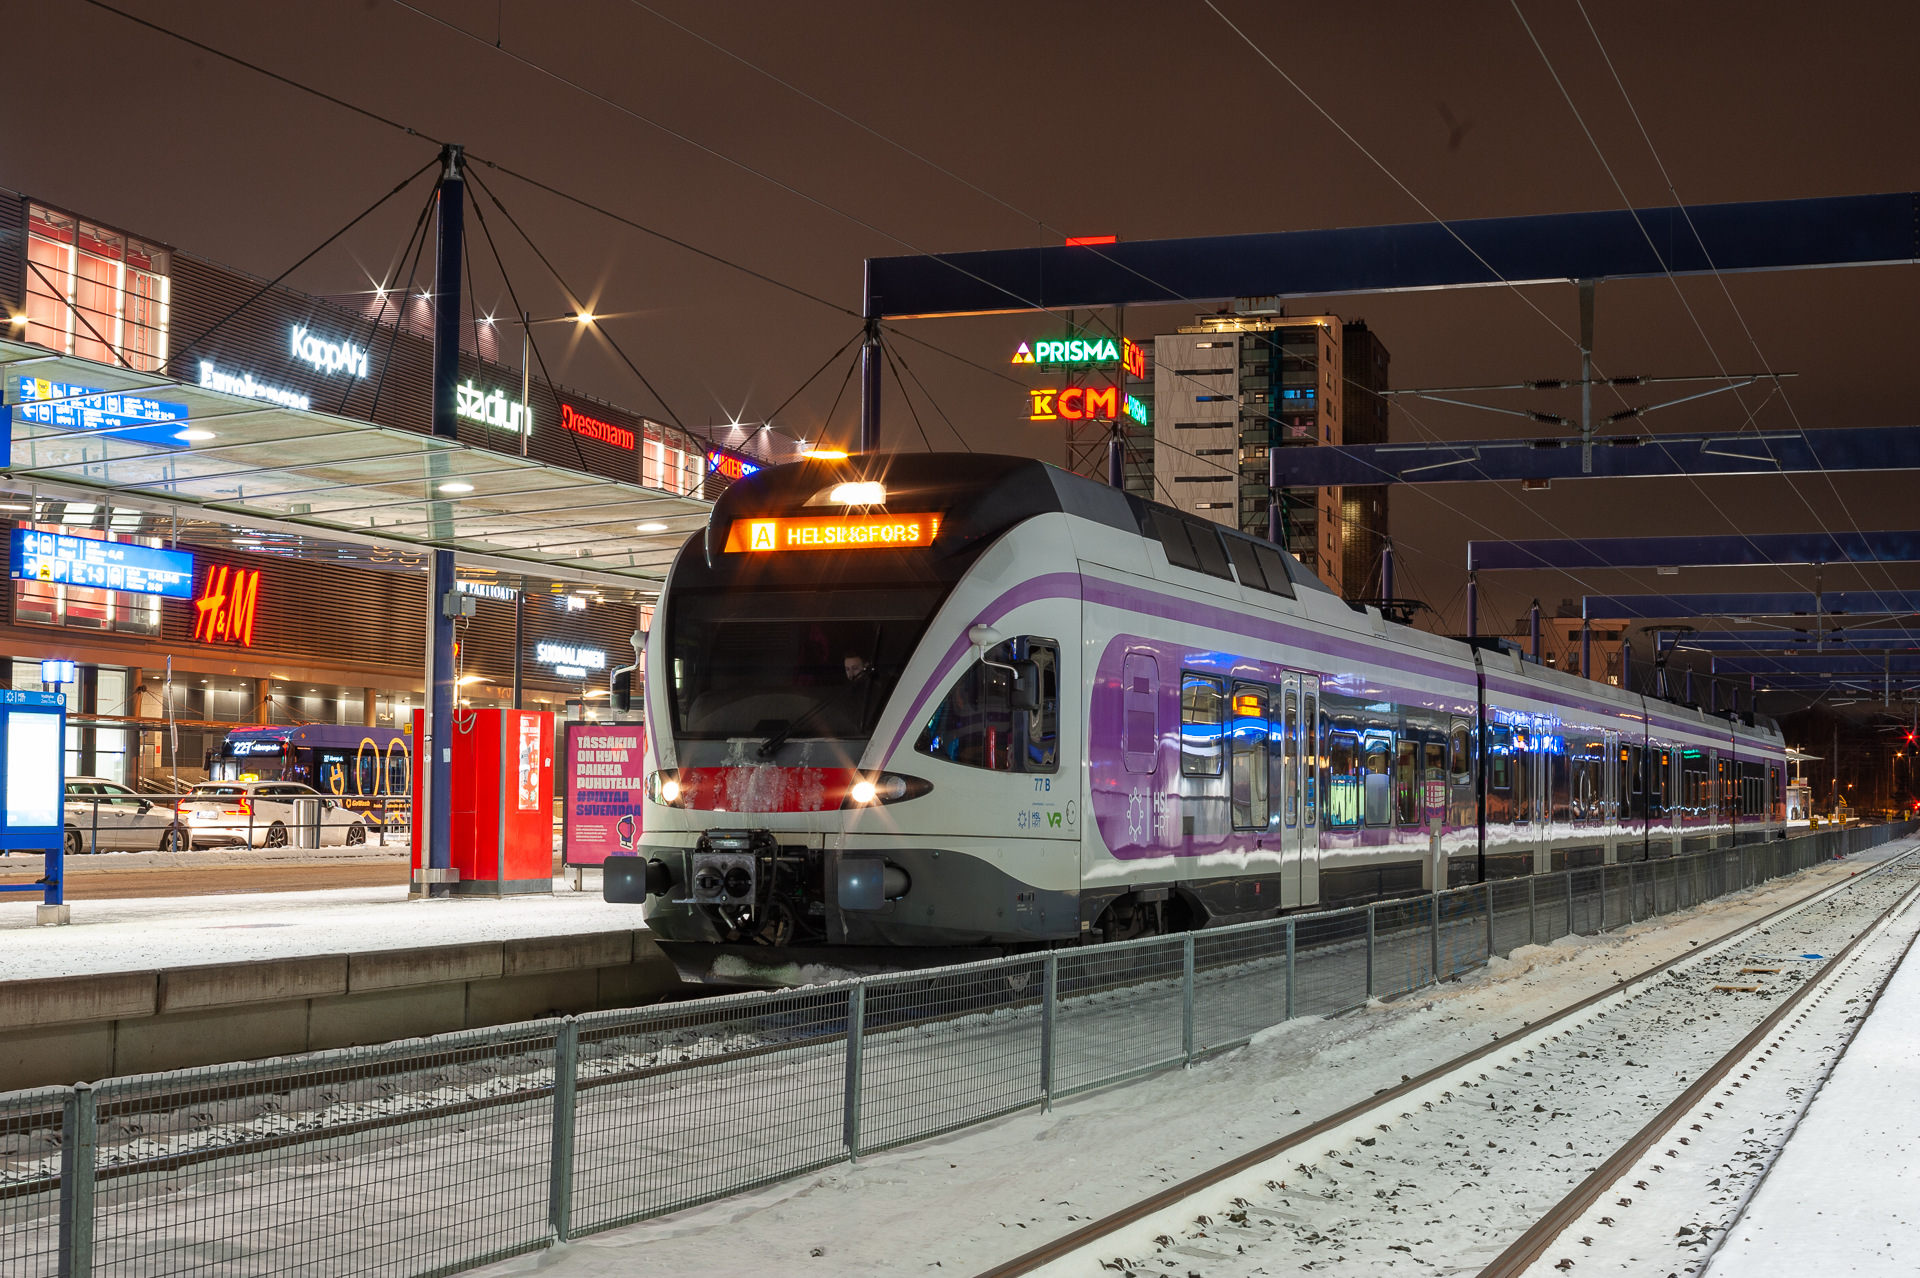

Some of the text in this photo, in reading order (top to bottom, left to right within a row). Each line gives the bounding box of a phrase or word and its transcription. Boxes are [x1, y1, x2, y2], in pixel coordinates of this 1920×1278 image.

[1035, 339, 1119, 363] PRISMA
[457, 380, 532, 436] stadium
[1128, 394, 1147, 426] PRISMA
[562, 404, 635, 451] Dressmann
[787, 523, 920, 545] HELSINGFORS
[195, 564, 260, 648] H&M
[233, 741, 251, 754] 227
[577, 735, 637, 749] TÄSSÄKIN
[577, 748, 629, 763] ON HYVÄ
[577, 763, 622, 776] PAIKKA
[576, 777, 641, 790] PUHUTELLA
[1034, 778, 1050, 791] 77 B
[577, 791, 629, 803] #PINTAA
[1153, 791, 1170, 813] HSL
[1031, 812, 1041, 820] HSL
[1031, 820, 1041, 828] HRT
[1046, 811, 1062, 828] VR
[1153, 816, 1170, 837] HRT
